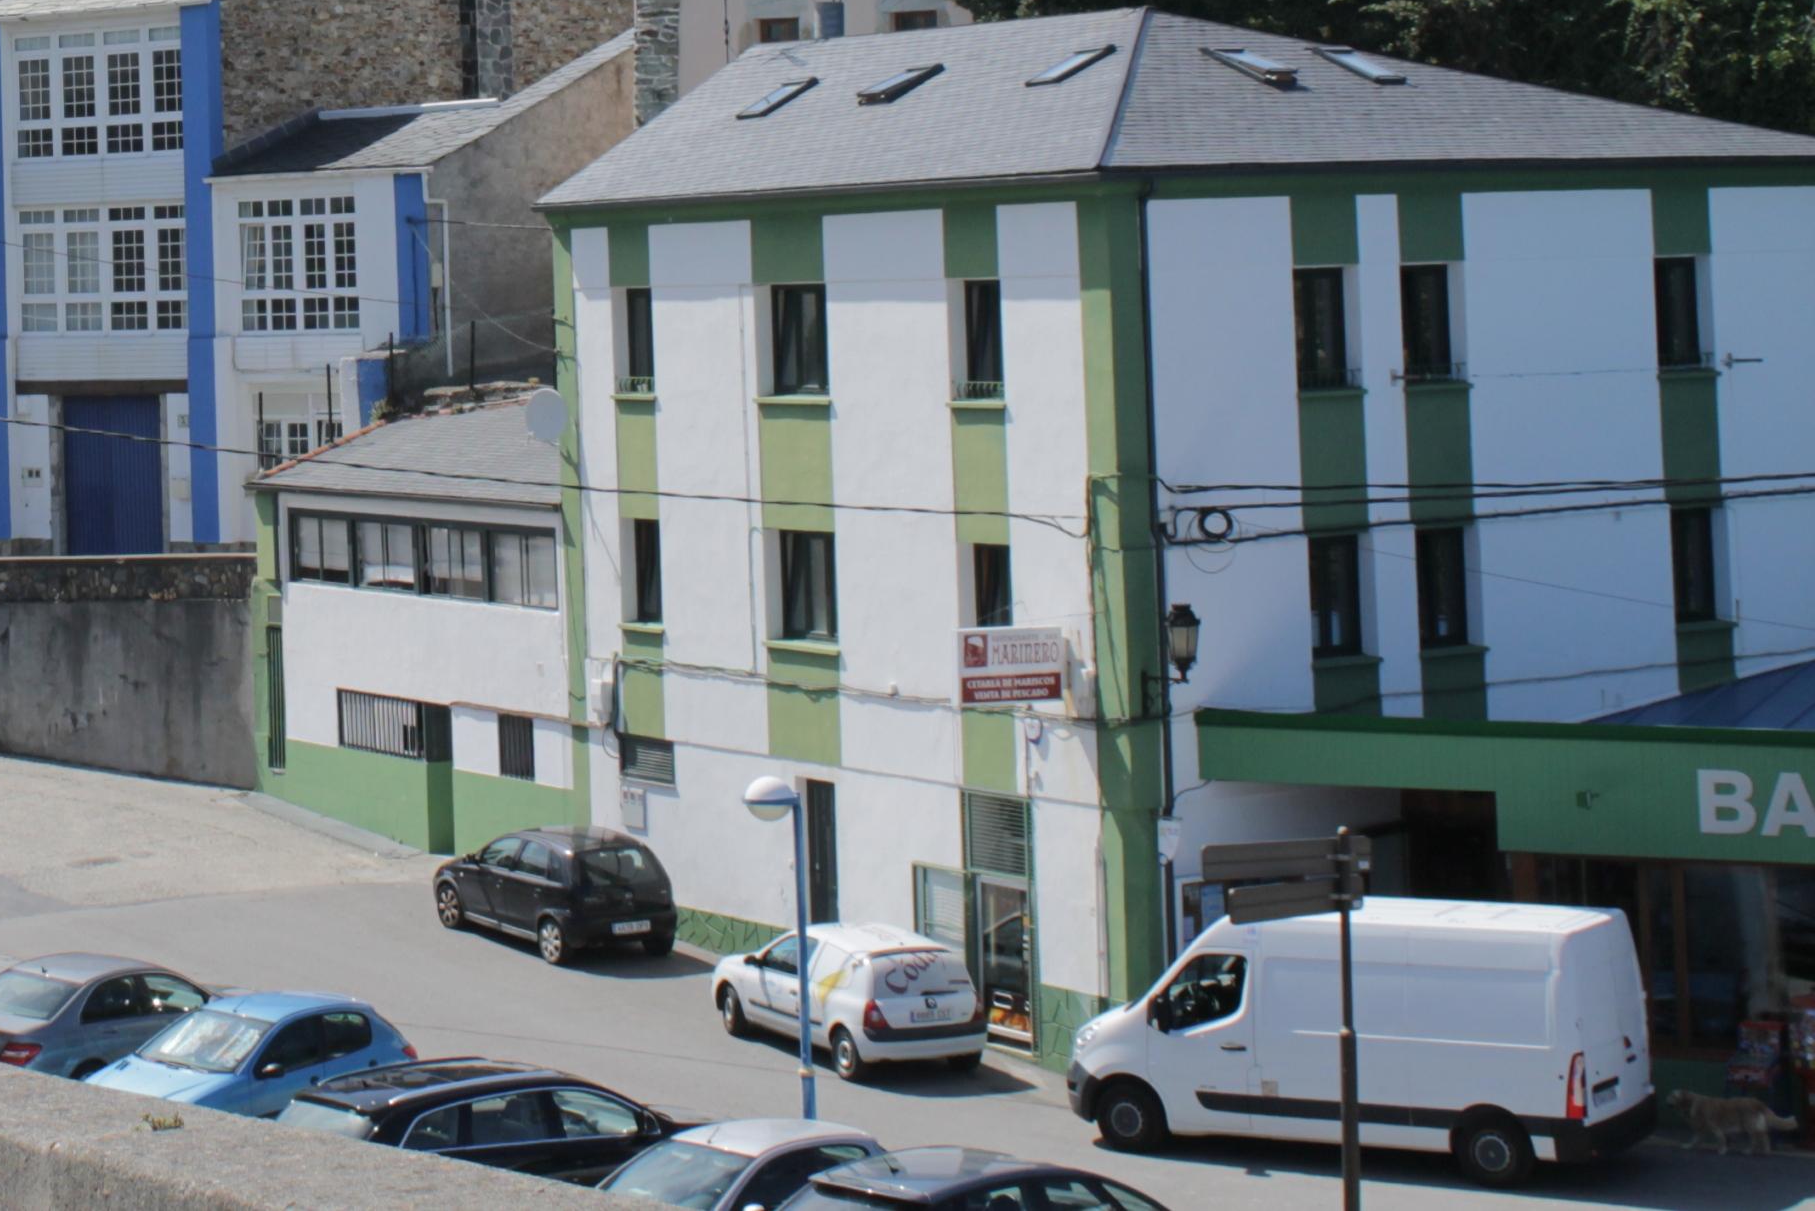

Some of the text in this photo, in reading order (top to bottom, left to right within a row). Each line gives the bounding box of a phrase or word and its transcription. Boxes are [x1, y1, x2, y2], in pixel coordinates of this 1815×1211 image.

[992, 641, 1060, 665] MARINERO
[1002, 678, 1014, 687] DE
[1697, 768, 1815, 838] BA
